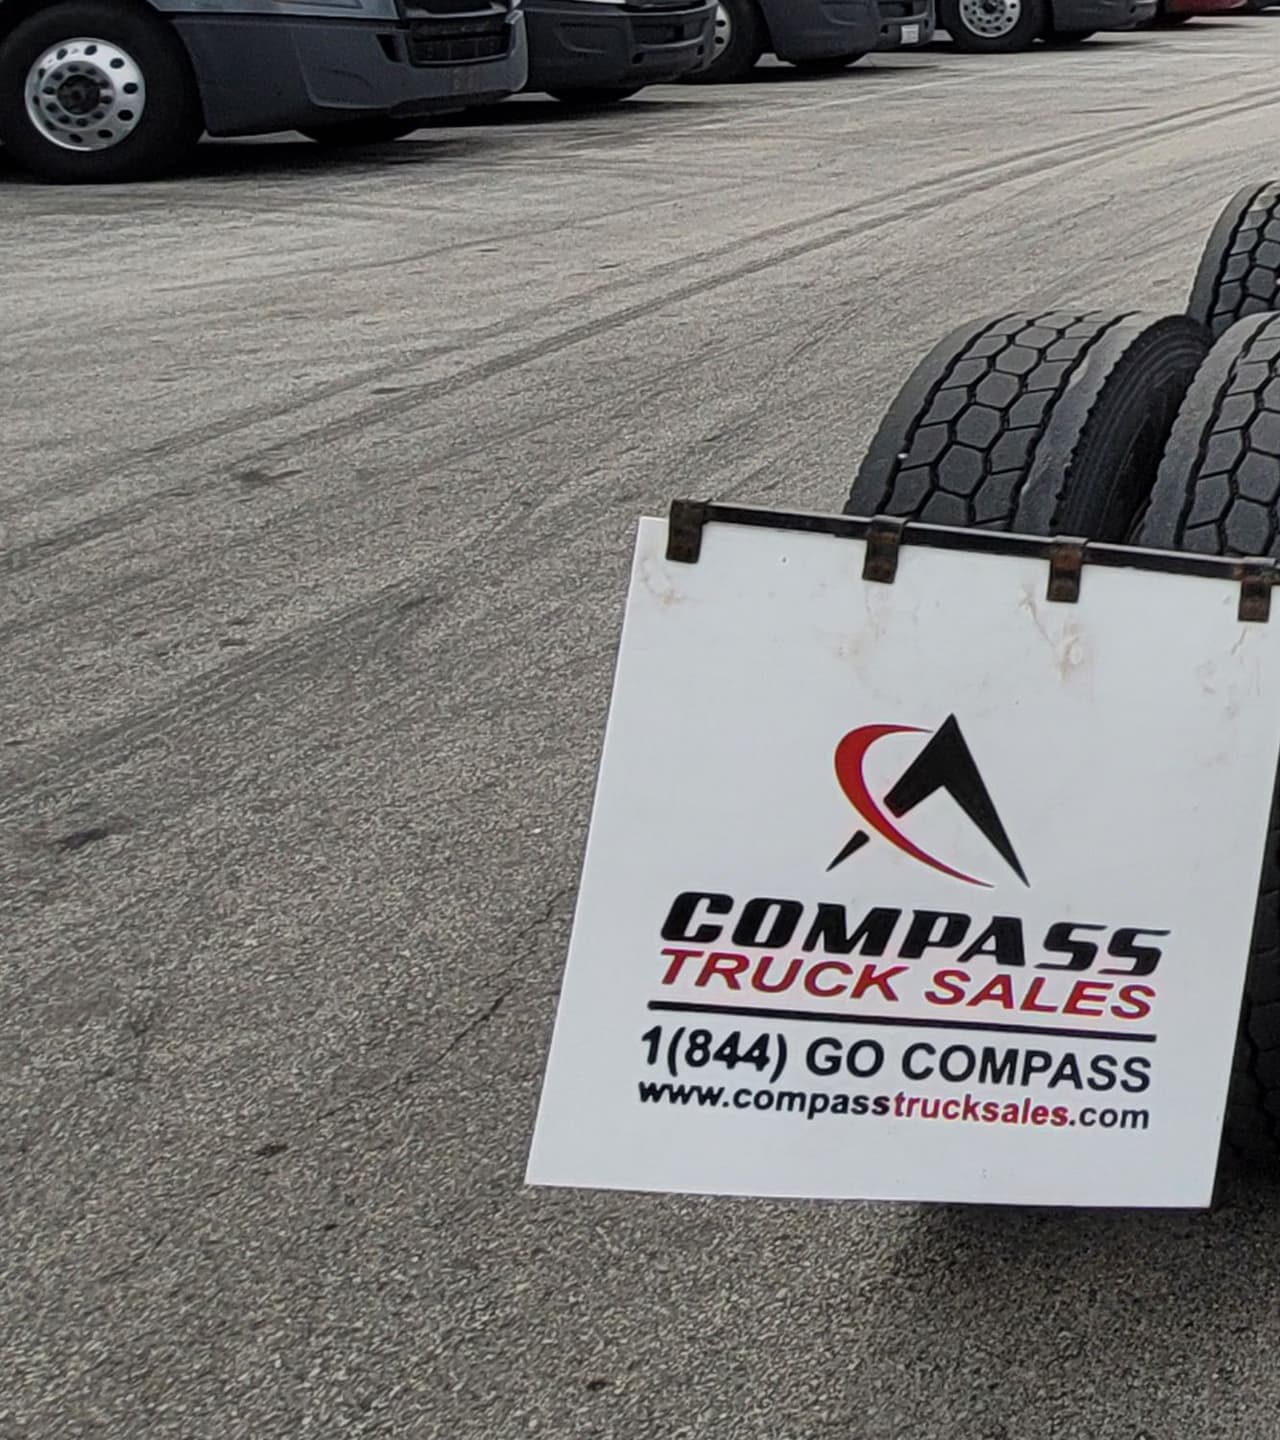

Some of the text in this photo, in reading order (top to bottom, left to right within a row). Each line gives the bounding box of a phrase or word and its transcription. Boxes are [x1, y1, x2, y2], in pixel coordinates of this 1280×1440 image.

[660, 891, 1171, 977] COMPASS
[660, 947, 1156, 1020] TRUCK SALES
[641, 1025, 1152, 1094] 1(844) GO COMPASS
[638, 1081, 1150, 1130] www.compasstrucksales.com
